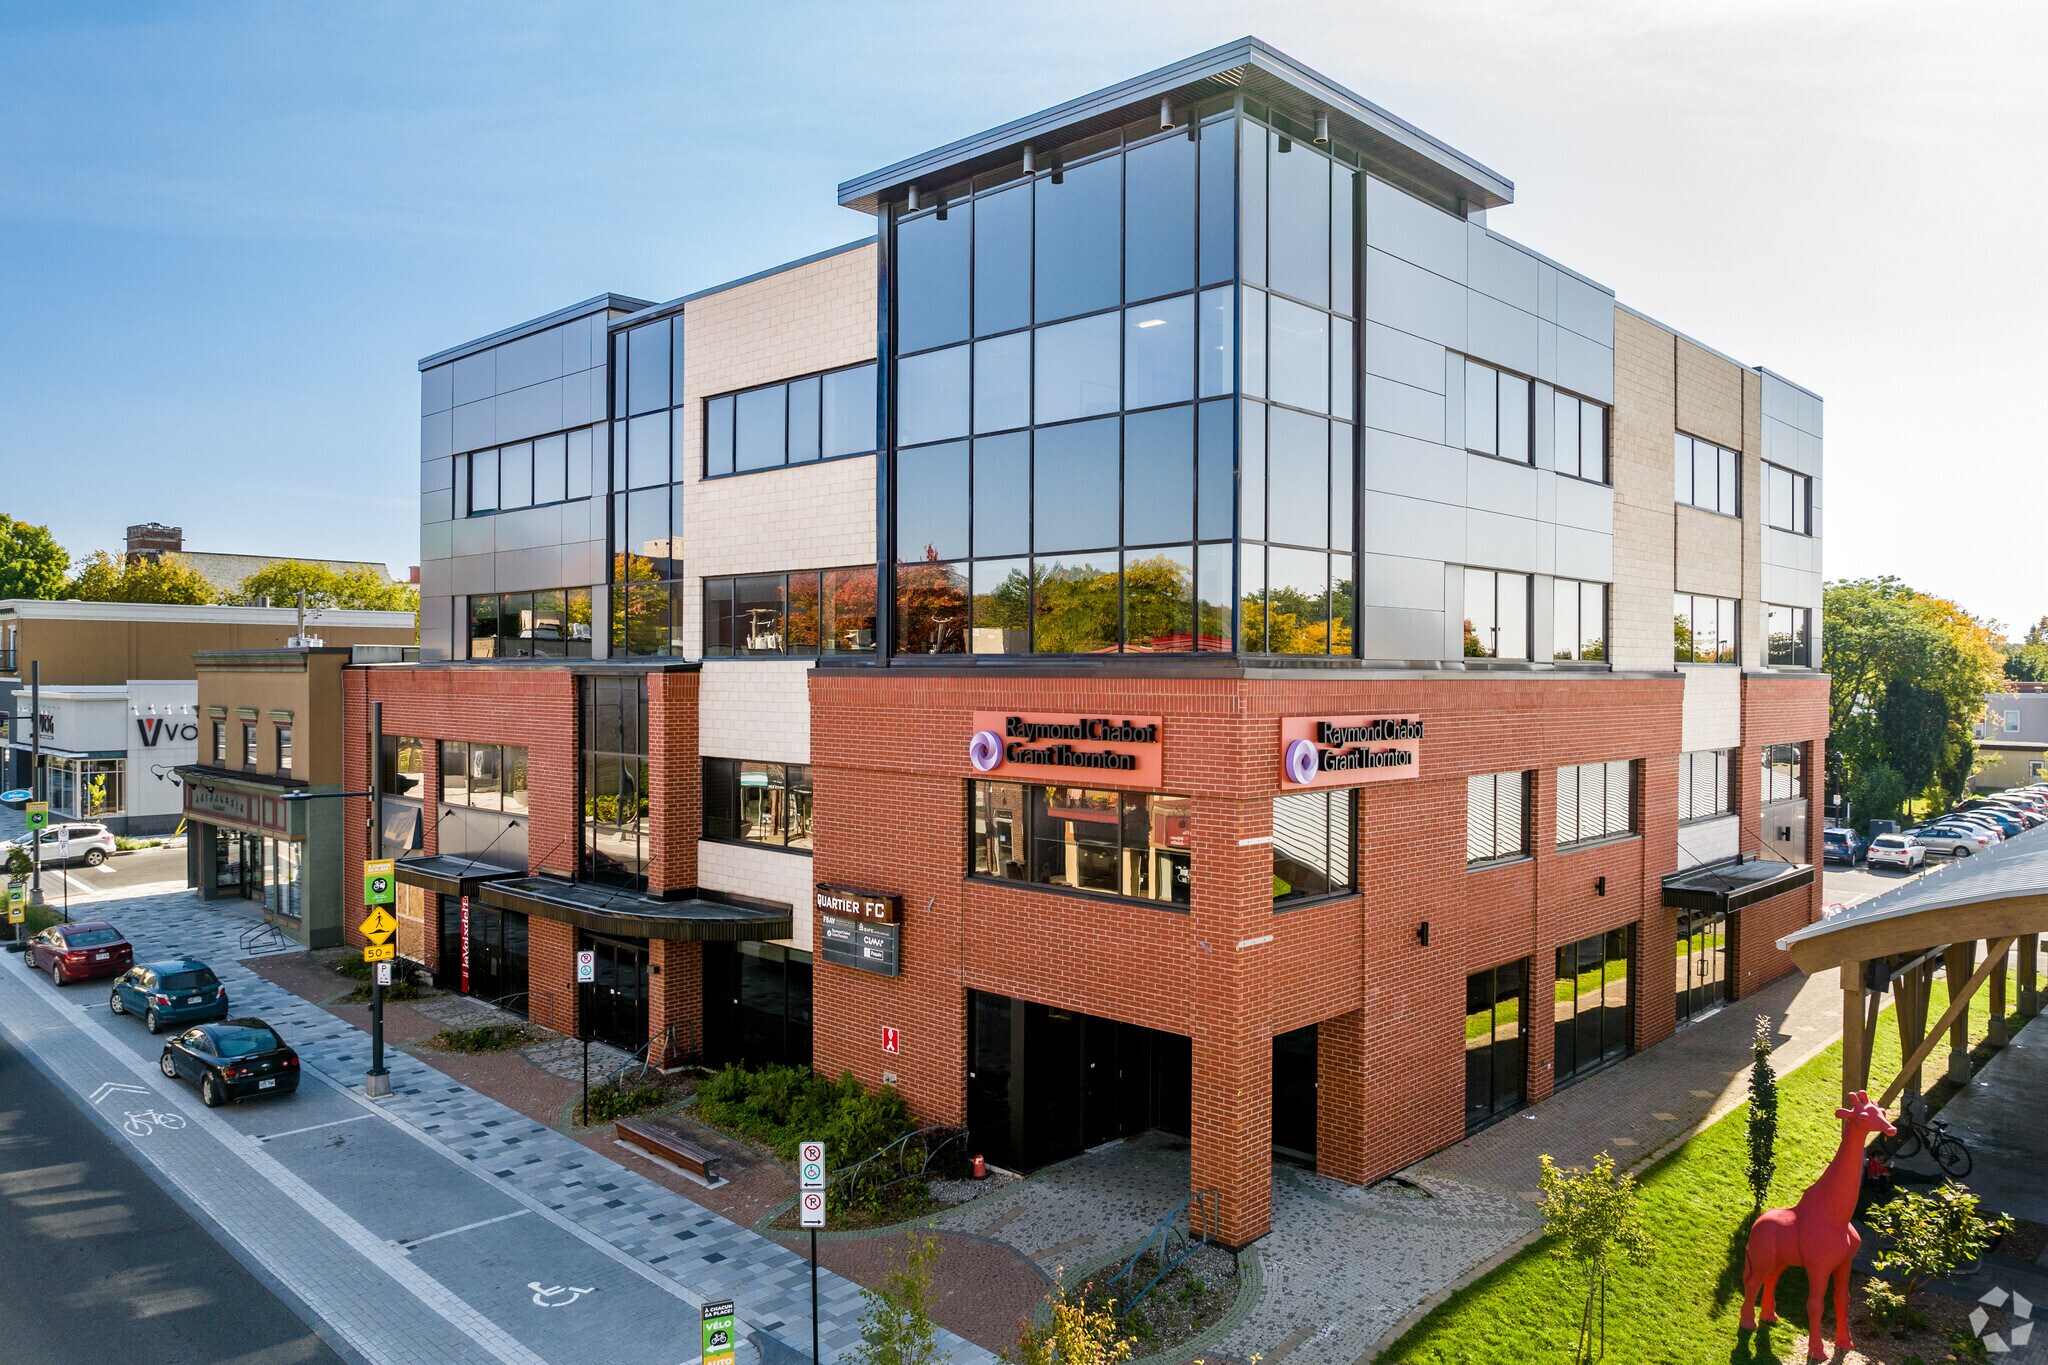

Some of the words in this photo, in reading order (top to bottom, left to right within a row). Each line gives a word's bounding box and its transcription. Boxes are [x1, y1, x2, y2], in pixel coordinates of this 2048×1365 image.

[1006, 717, 1087, 743] Raymond
[1086, 718, 1157, 743] Chabot
[1321, 720, 1382, 748] Raymond
[1384, 719, 1424, 740] Chabot
[1005, 742, 1054, 765] Grant
[1052, 744, 1135, 770] Thornton
[1321, 749, 1359, 771] Grant
[1360, 747, 1412, 768] Thornton
[817, 894, 860, 914] QUARTIER
[865, 902, 885, 918] FC
[368, 949, 382, 958] 50
[381, 964, 387, 973] P
[709, 1304, 733, 1312] CHACUN
[713, 1308, 733, 1317] PLACE!
[706, 1319, 732, 1331] VÉLO
